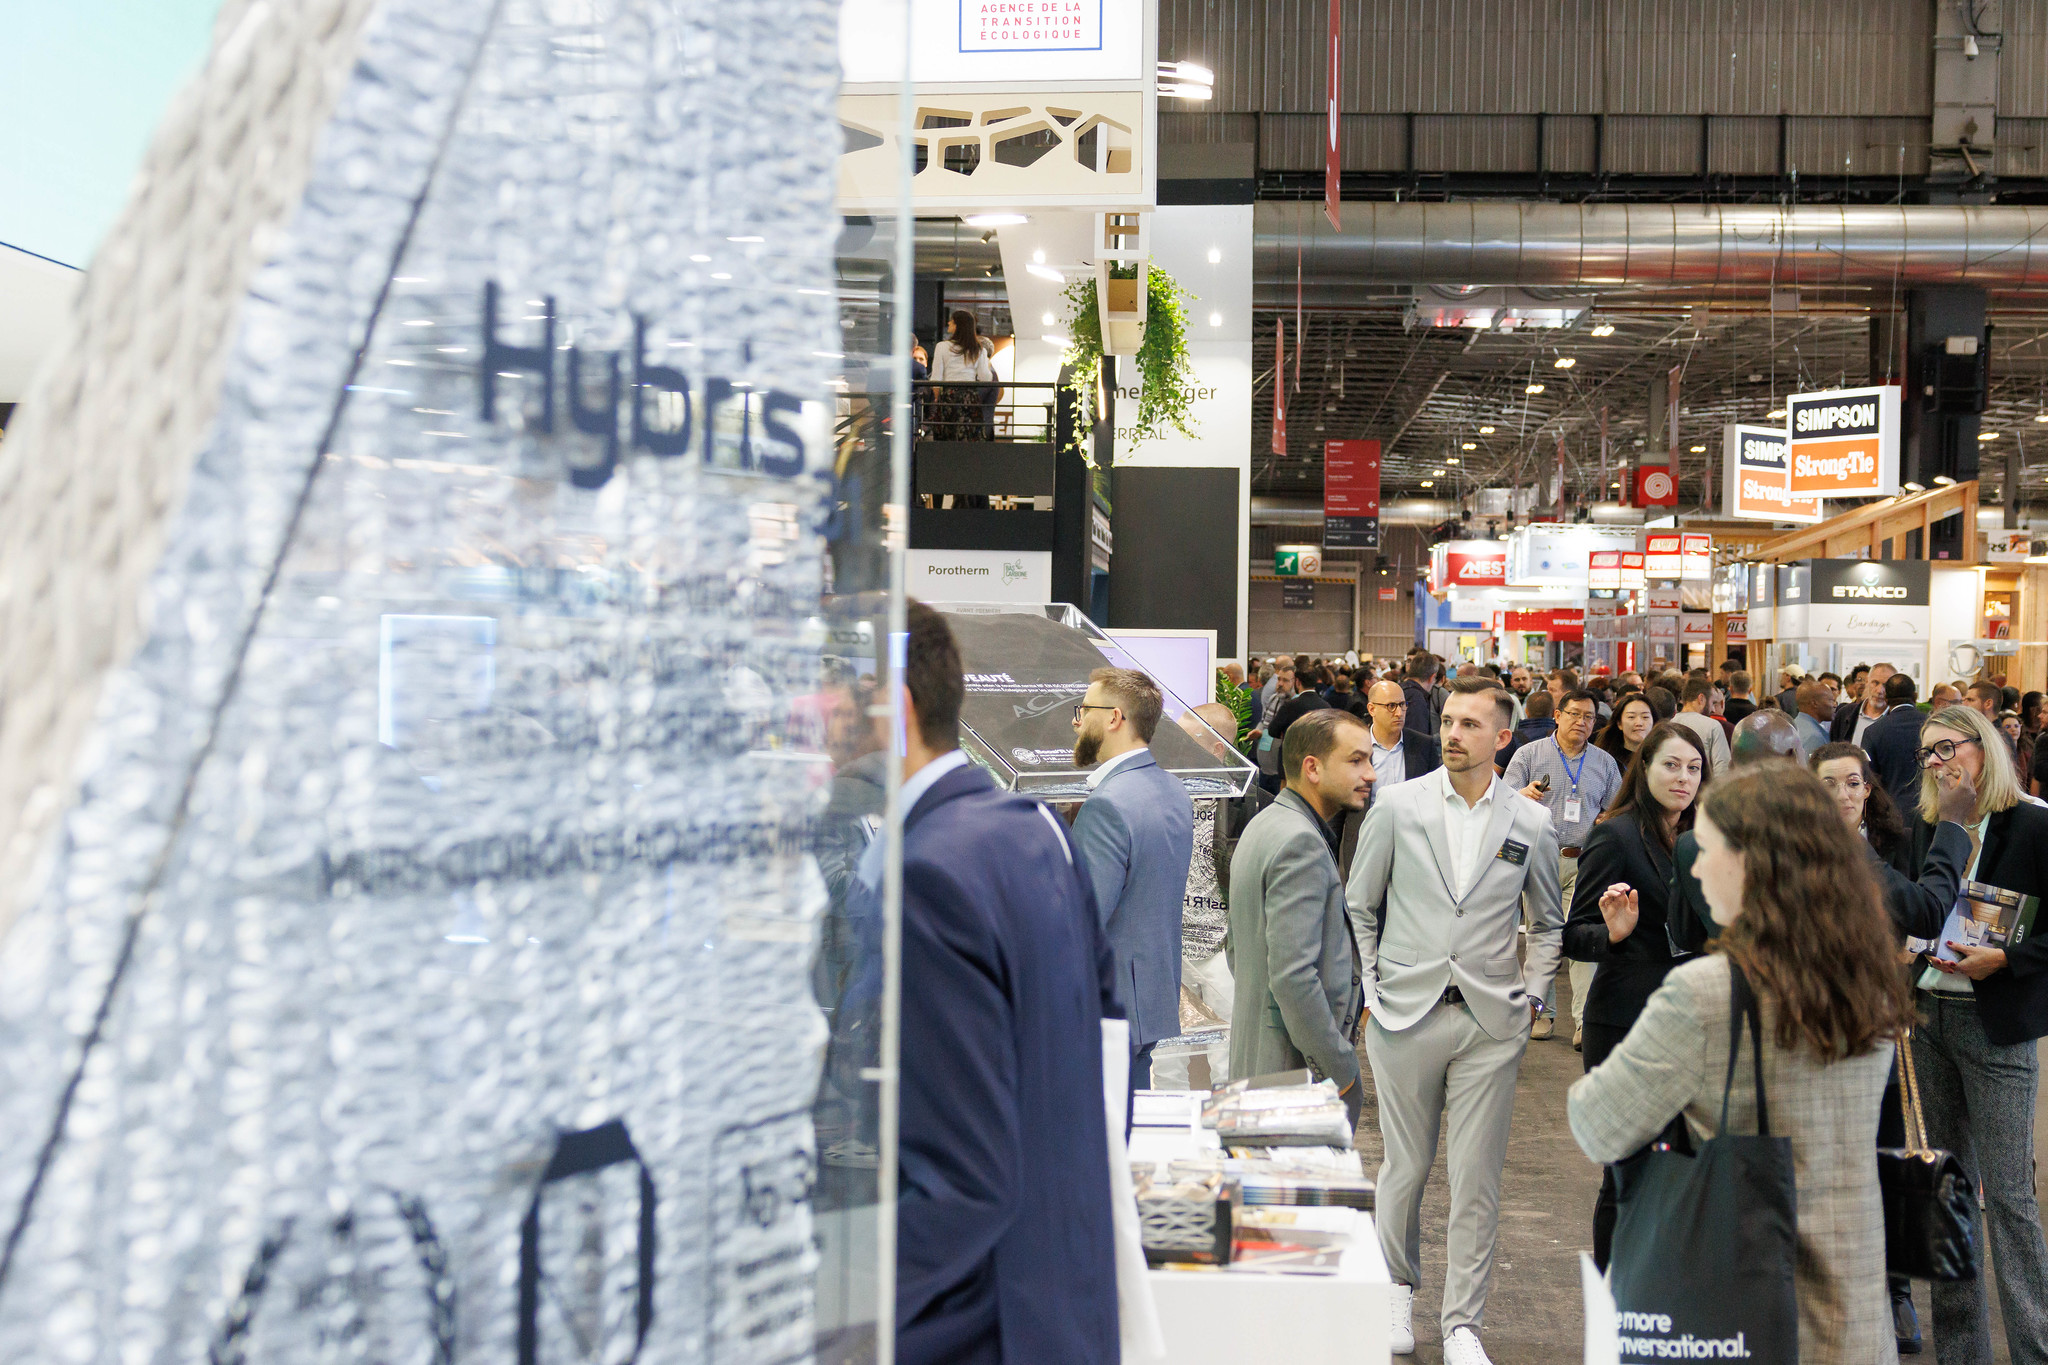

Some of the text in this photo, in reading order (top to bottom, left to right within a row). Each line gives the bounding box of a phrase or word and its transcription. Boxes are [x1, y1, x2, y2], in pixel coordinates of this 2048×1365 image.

[981, 2, 1081, 13] AGENCE DE LA
[981, 16, 1081, 27] TRANSITION
[980, 28, 1081, 40] ÉCOLOGIQUE
[480, 280, 806, 490] Hybris
[1796, 403, 1876, 432] SIMPSON
[1795, 451, 1875, 481] Strong-Tie
[928, 565, 990, 576] Porotherm
[1832, 585, 1908, 599] ETANCO
[1623, 1311, 1673, 1333] more
[1618, 1331, 1752, 1359] nversational.
